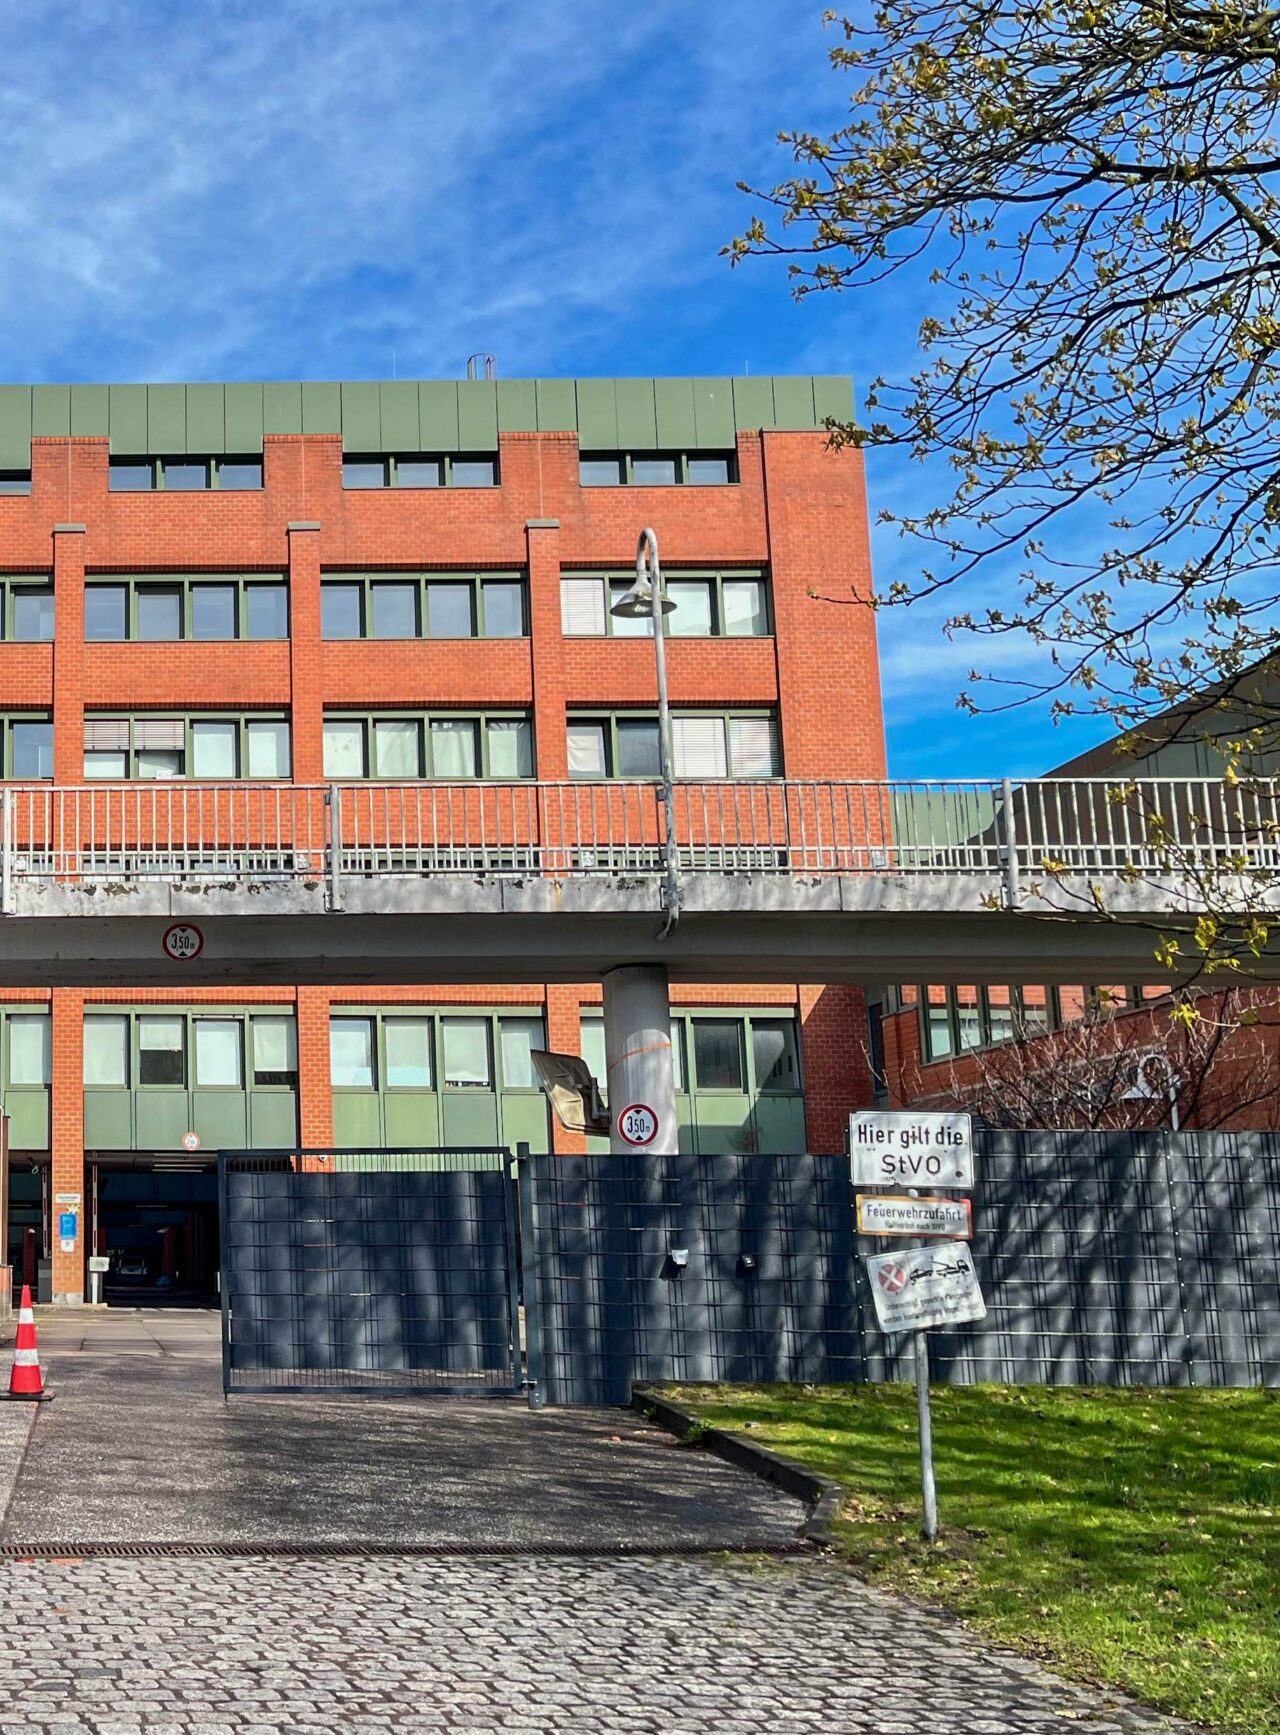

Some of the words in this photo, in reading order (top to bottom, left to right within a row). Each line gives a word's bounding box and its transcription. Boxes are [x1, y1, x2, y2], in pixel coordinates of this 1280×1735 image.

[171, 933, 190, 951] 3,50
[627, 1116, 645, 1135] 3,50
[858, 1124, 895, 1144] Hier
[900, 1125, 930, 1149] gilt
[935, 1126, 963, 1146] die
[881, 1154, 941, 1175] StVO
[867, 1204, 962, 1221] Feuerwehrzufahrt
